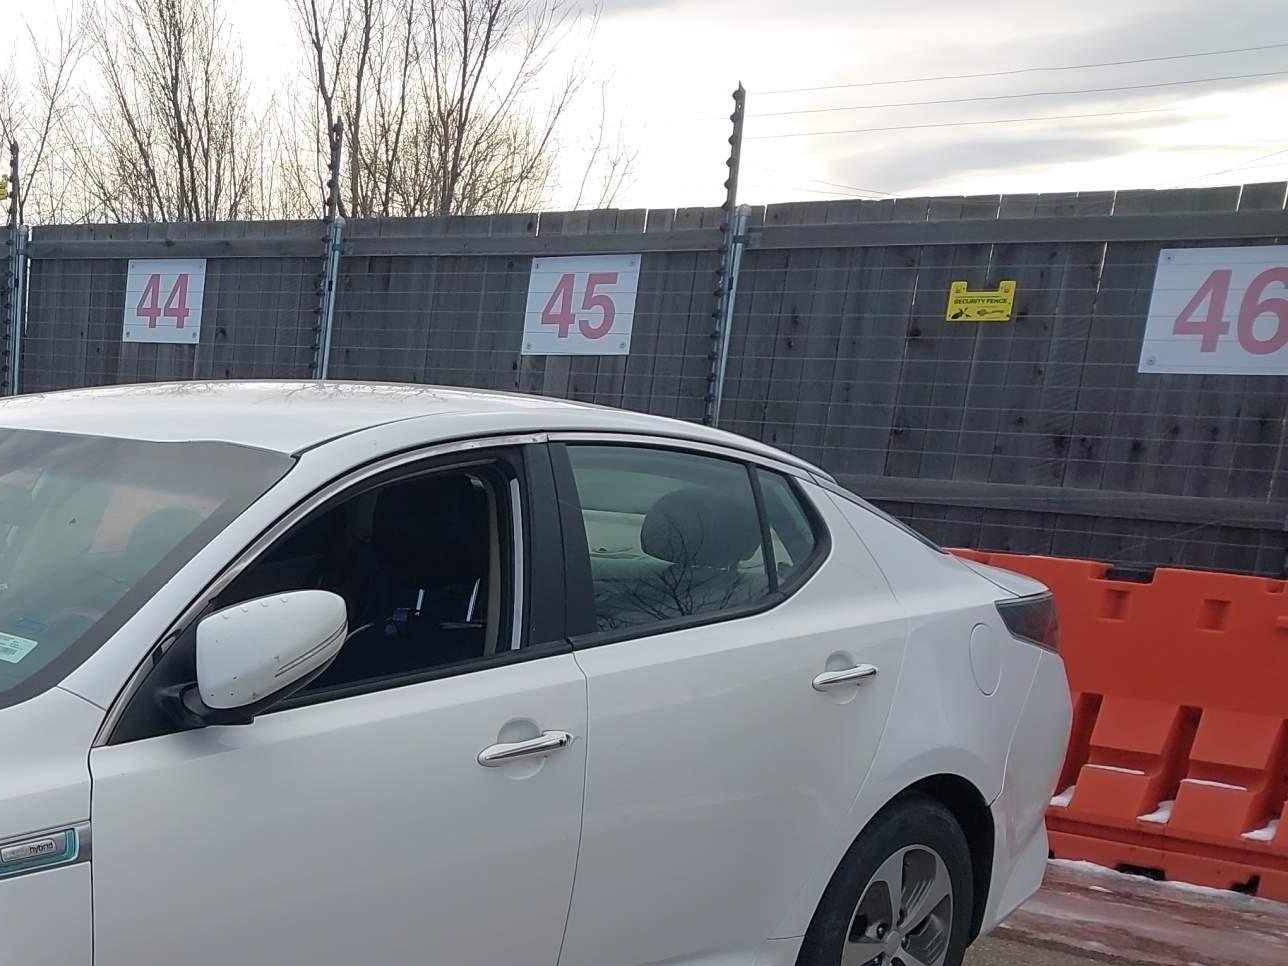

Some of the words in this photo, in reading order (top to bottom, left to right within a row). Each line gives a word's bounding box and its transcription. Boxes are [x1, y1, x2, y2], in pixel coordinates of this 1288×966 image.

[136, 273, 190, 329] 44
[541, 272, 618, 340] 45
[1172, 266, 1288, 355] 46
[29, 842, 53, 855] hybrid
